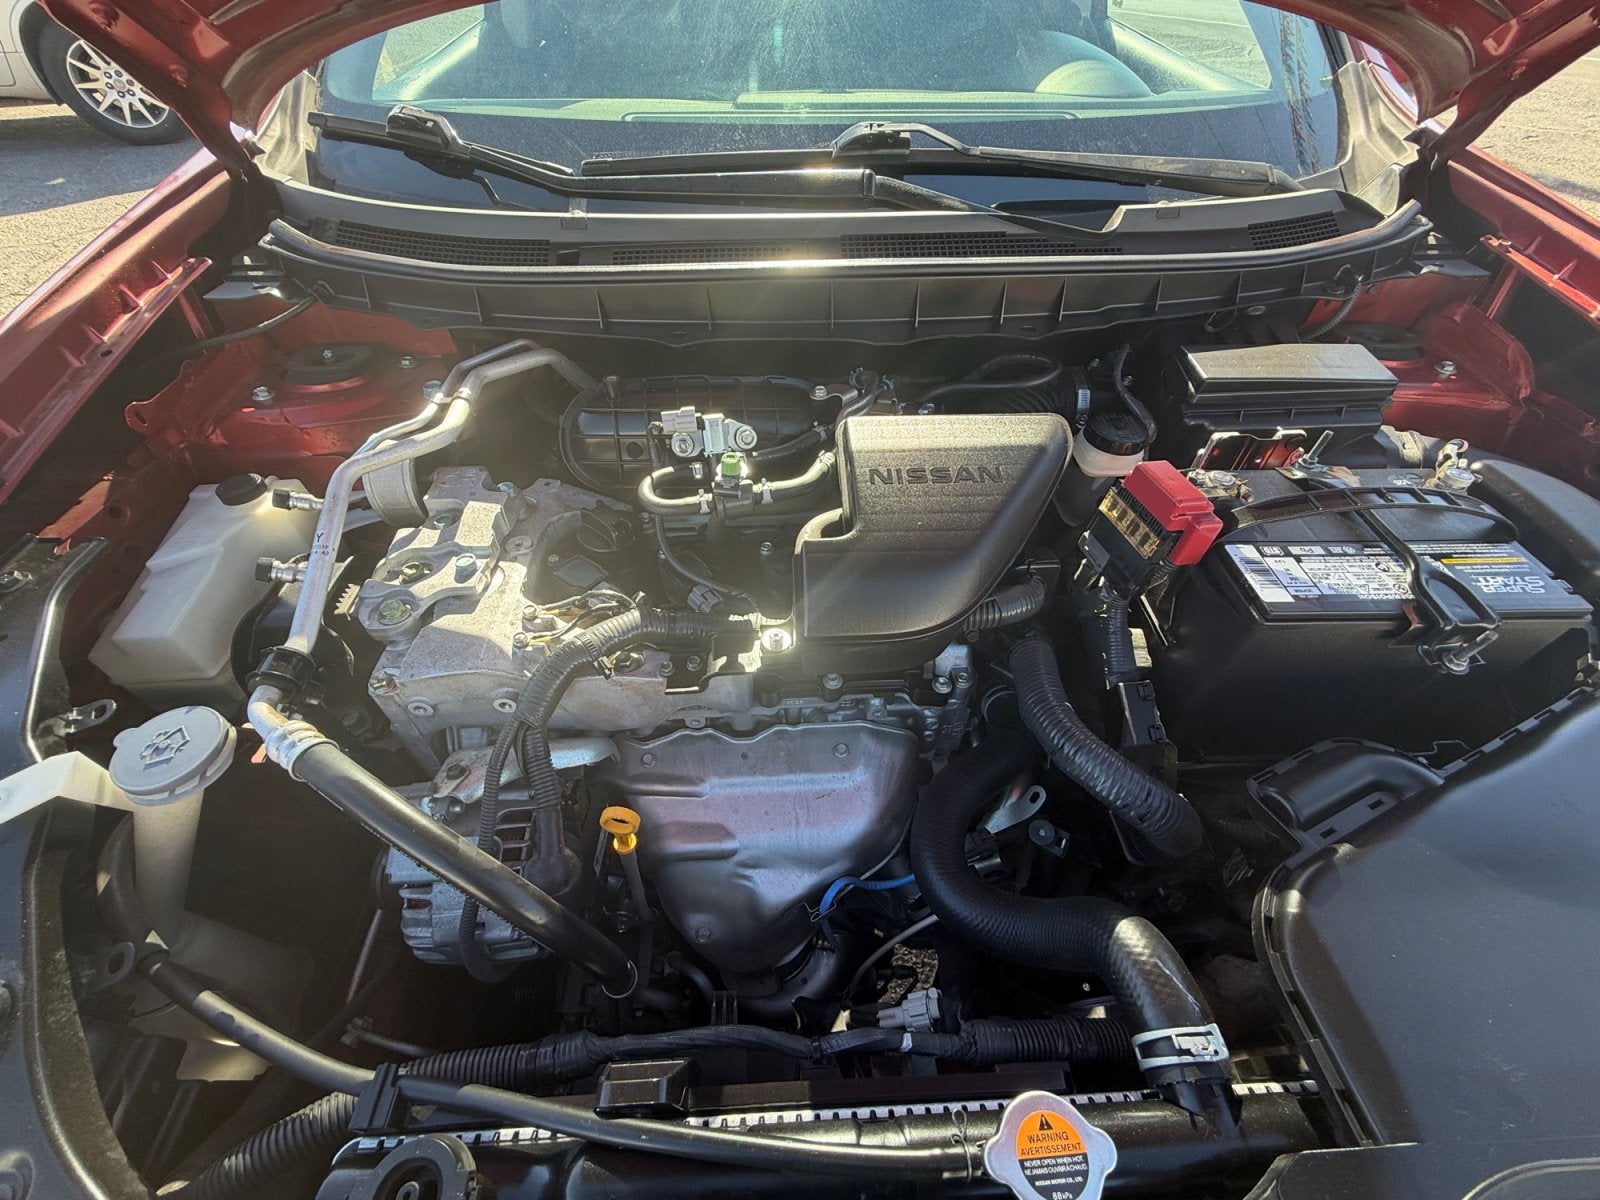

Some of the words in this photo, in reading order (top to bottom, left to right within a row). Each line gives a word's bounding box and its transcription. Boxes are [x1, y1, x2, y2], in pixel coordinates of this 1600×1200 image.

[868, 465, 1003, 484] NISSAN
[1475, 576, 1545, 586] START
[1481, 585, 1546, 593] SUPER
[1027, 1131, 1069, 1143] WARNING
[1021, 1143, 1081, 1156] AVERTISSEMENT
[1041, 1158, 1057, 1166] OPEN
[1032, 1166, 1049, 1175] JAMAIS
[1048, 1165, 1066, 1173] OUVRIR
